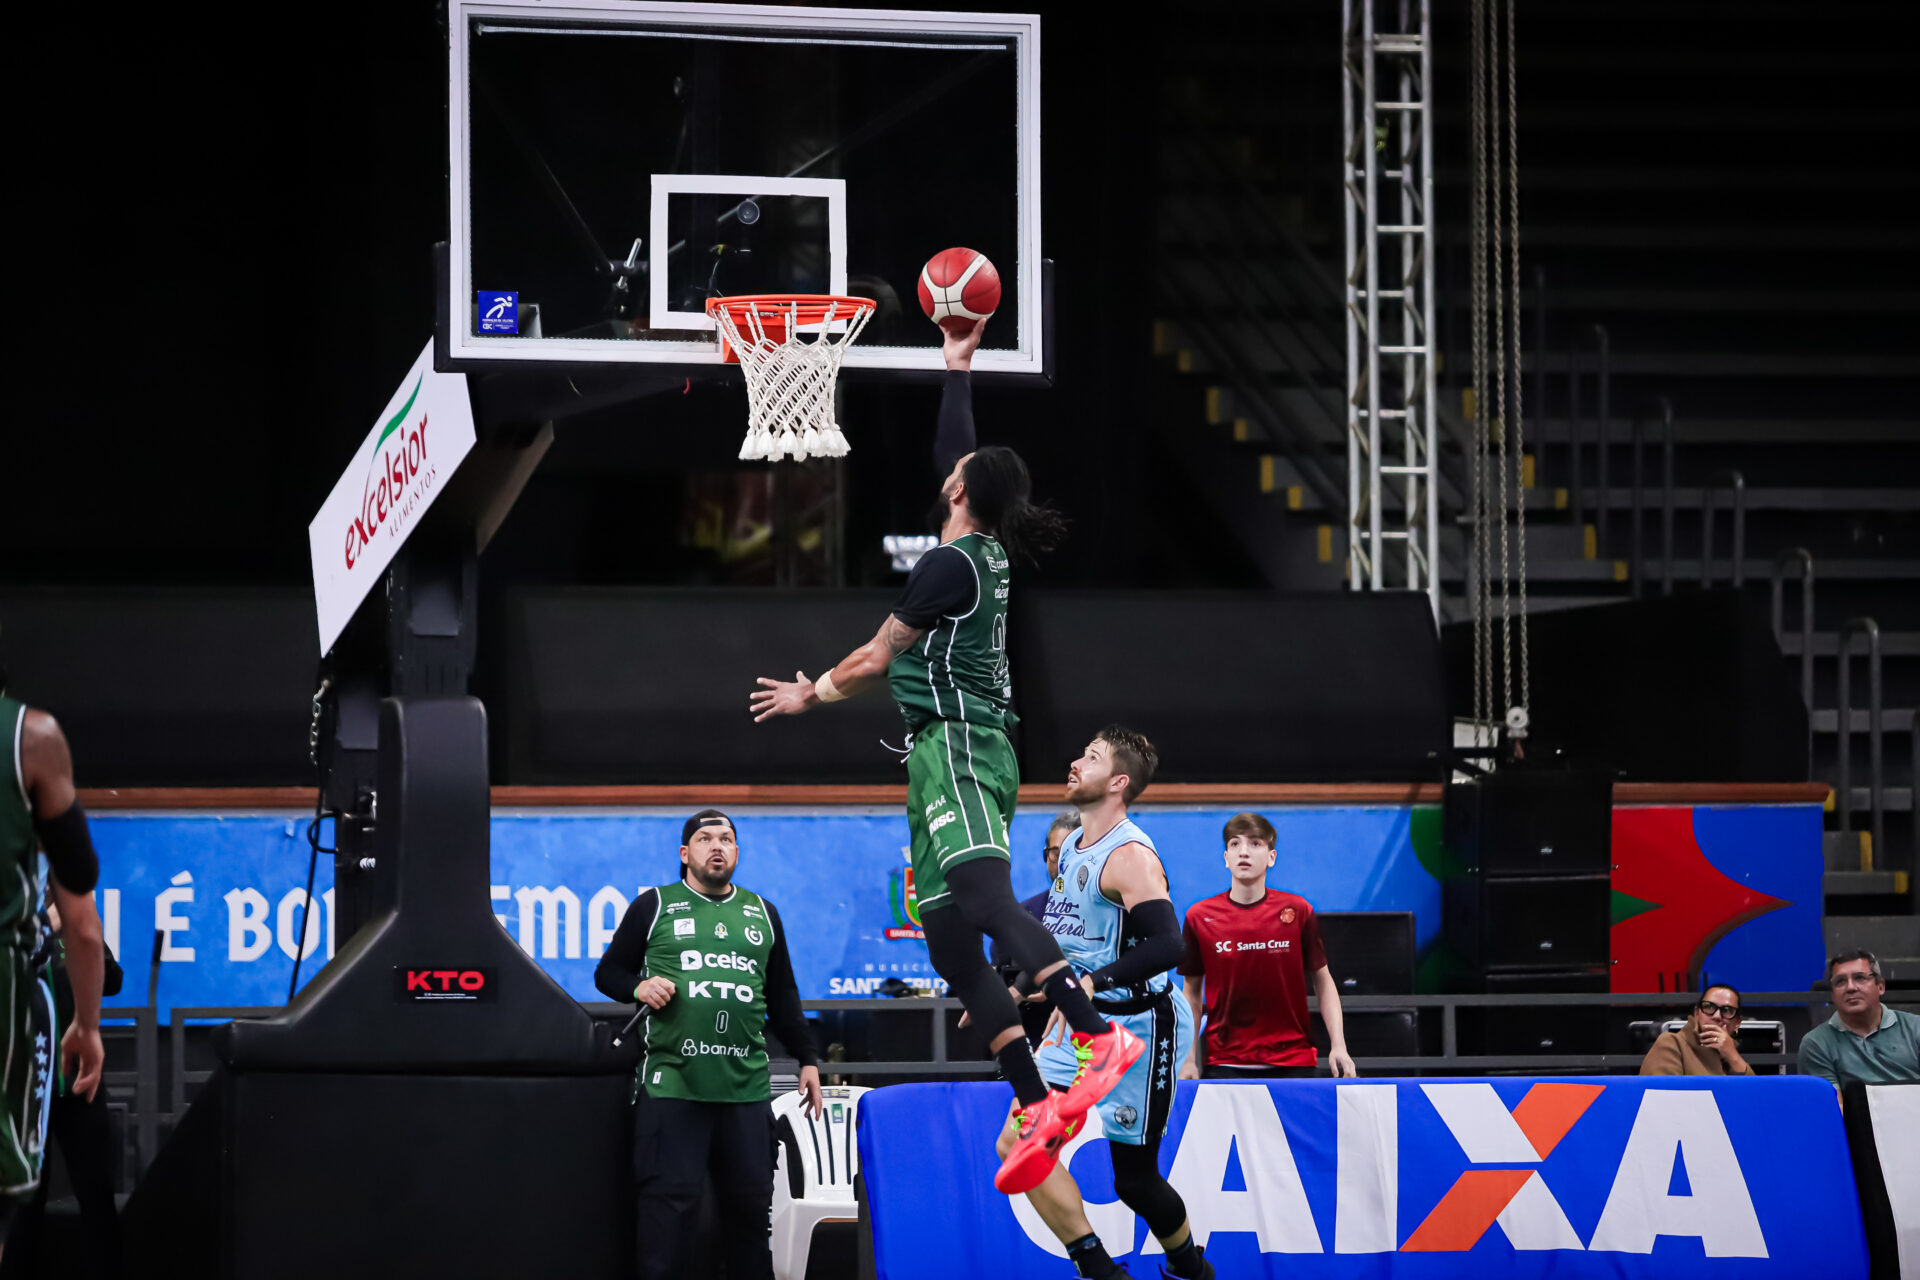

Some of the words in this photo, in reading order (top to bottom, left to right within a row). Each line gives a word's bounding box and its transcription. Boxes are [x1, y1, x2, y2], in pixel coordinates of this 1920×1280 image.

[345, 412, 427, 570] excelsior
[388, 464, 436, 538] ALIMENTOS
[155, 870, 195, 962] É
[1216, 941, 1232, 953] SC
[1237, 942, 1266, 951] Santa
[1267, 940, 1290, 949] Cruz
[704, 951, 757, 974] ceisc
[865, 963, 929, 972] MUNICI
[407, 971, 484, 990] KTO
[829, 978, 885, 995] SANT
[689, 981, 753, 1002] KTO
[716, 1010, 728, 1033] 0
[700, 1041, 749, 1057] banrisul
